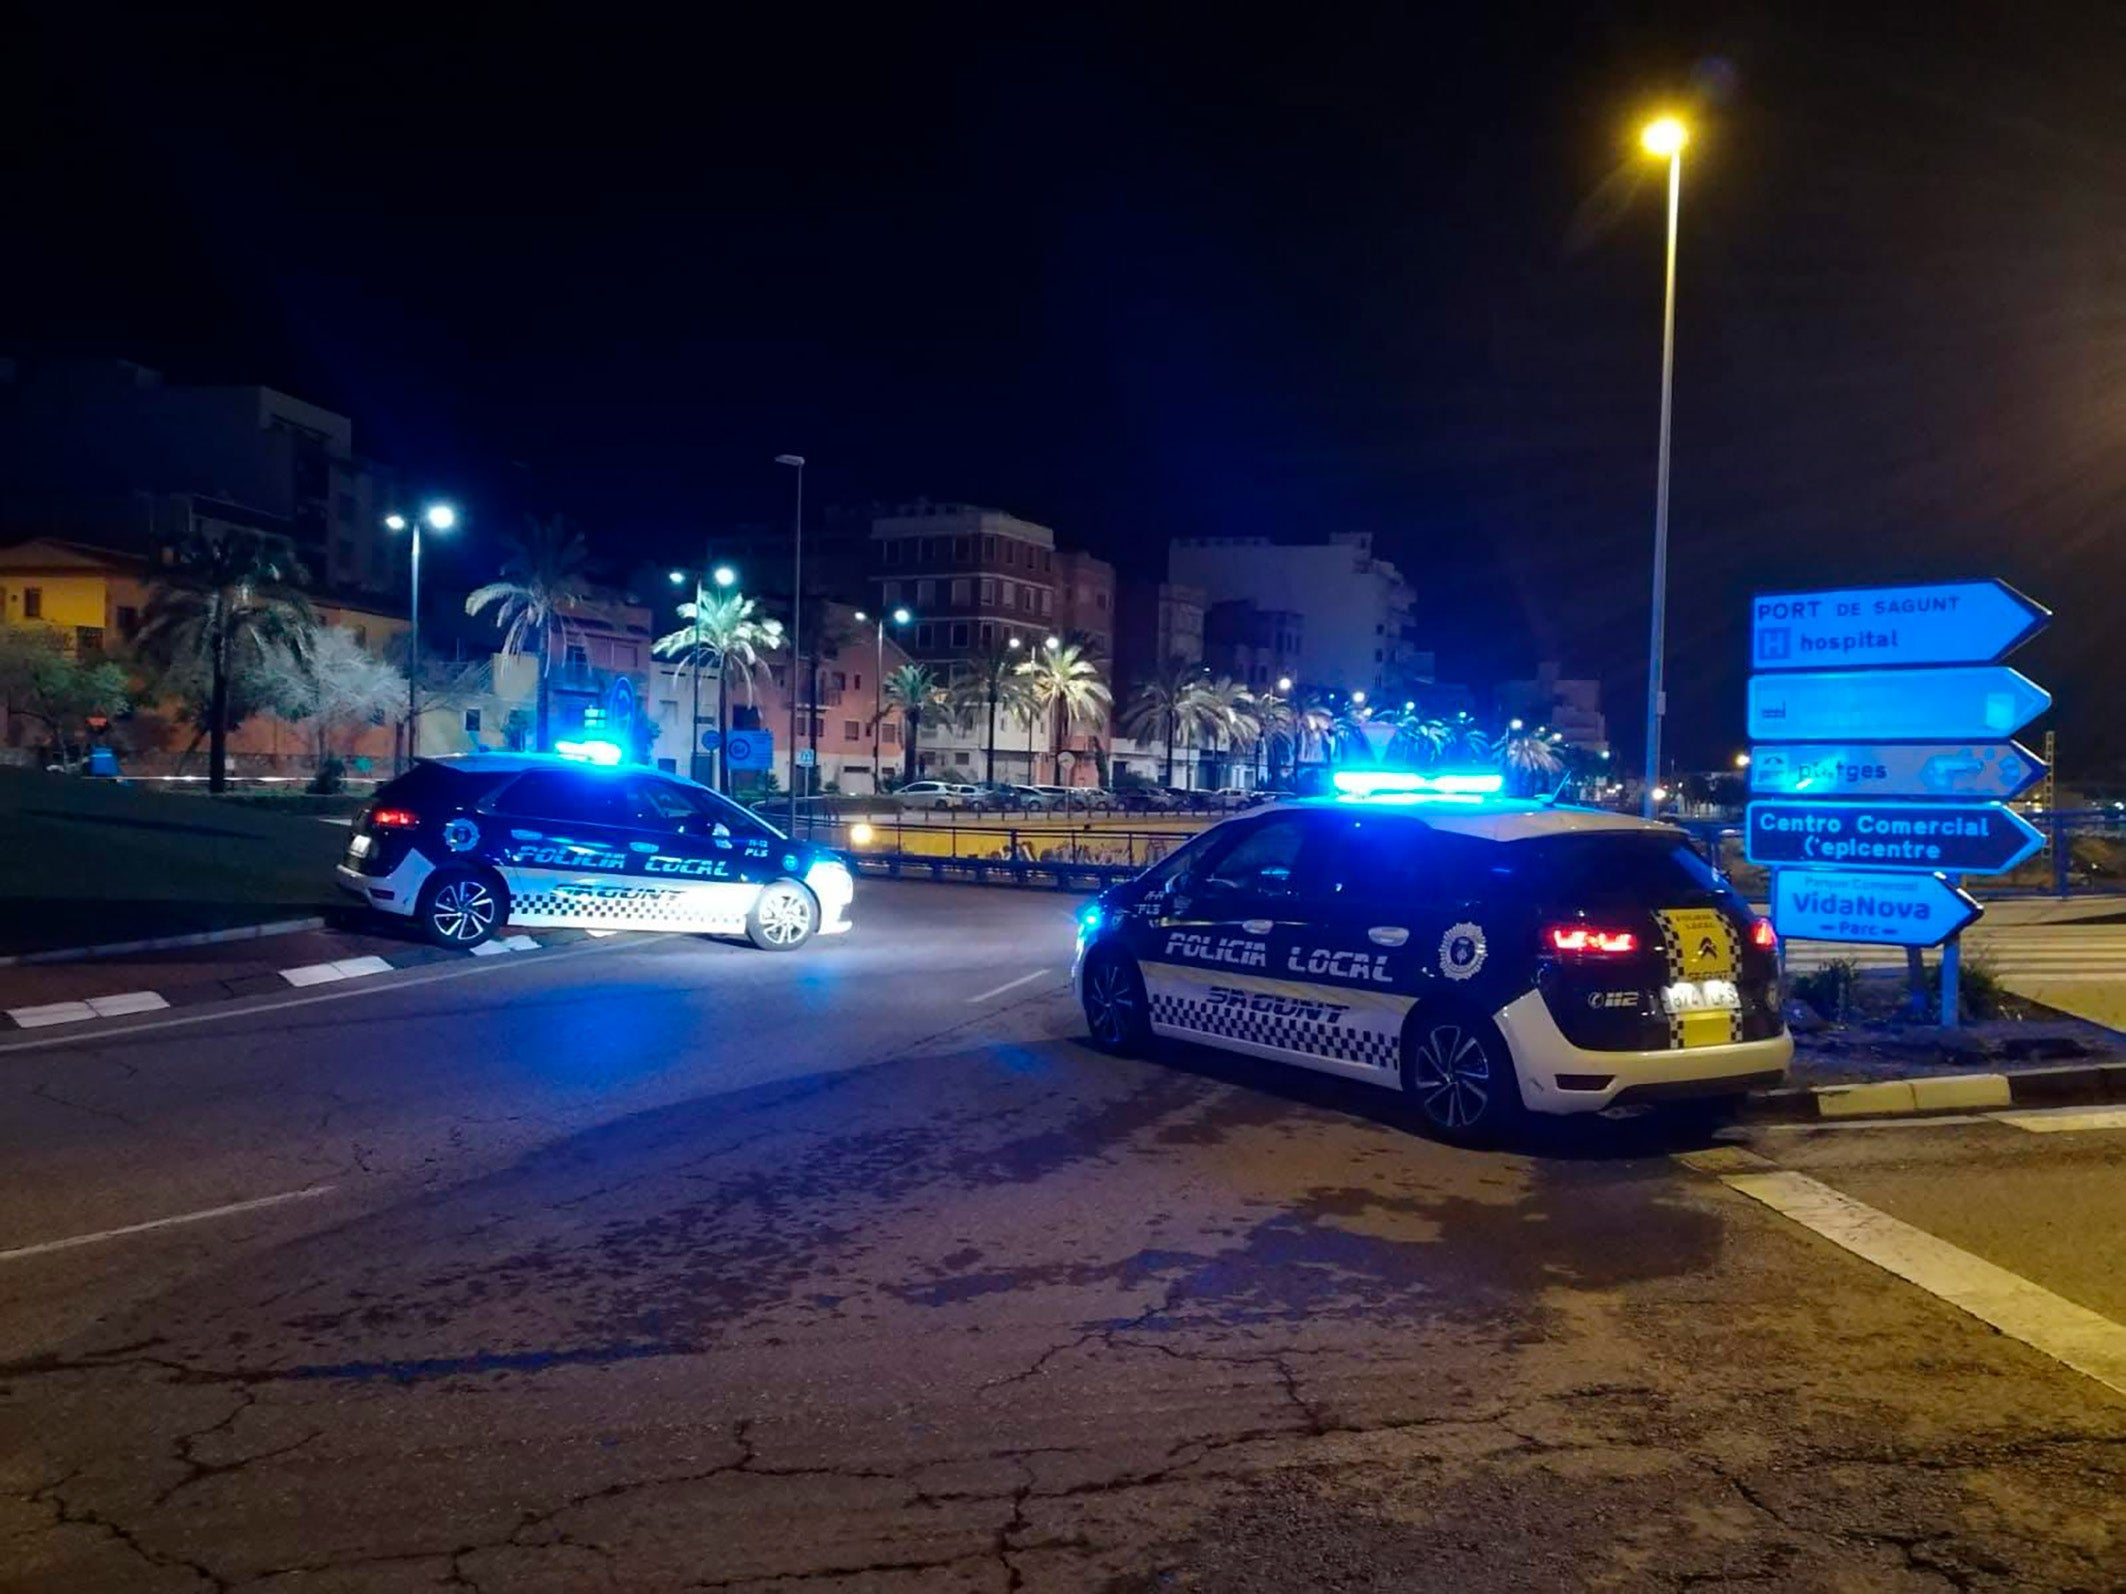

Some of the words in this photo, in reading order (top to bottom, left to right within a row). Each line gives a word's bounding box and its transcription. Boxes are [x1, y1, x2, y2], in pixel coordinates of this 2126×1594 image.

[1758, 601, 1821, 621] PORT
[1837, 601, 1861, 617] DE
[1873, 596, 1960, 615] SAGUNT
[1800, 630, 1899, 652] hospital
[1759, 813, 1842, 833] Centro
[1856, 815, 1990, 837] Comercial
[517, 846, 627, 869] POLICIA
[644, 856, 729, 876] LOCAL
[1792, 892, 1931, 920] VidaNova
[1839, 921, 1878, 936] Parc
[1164, 932, 1267, 967] POLICIA
[1287, 946, 1394, 982] LOCAL
[1205, 986, 1351, 1024] SAGUNT
[1604, 991, 1640, 1007] 112
